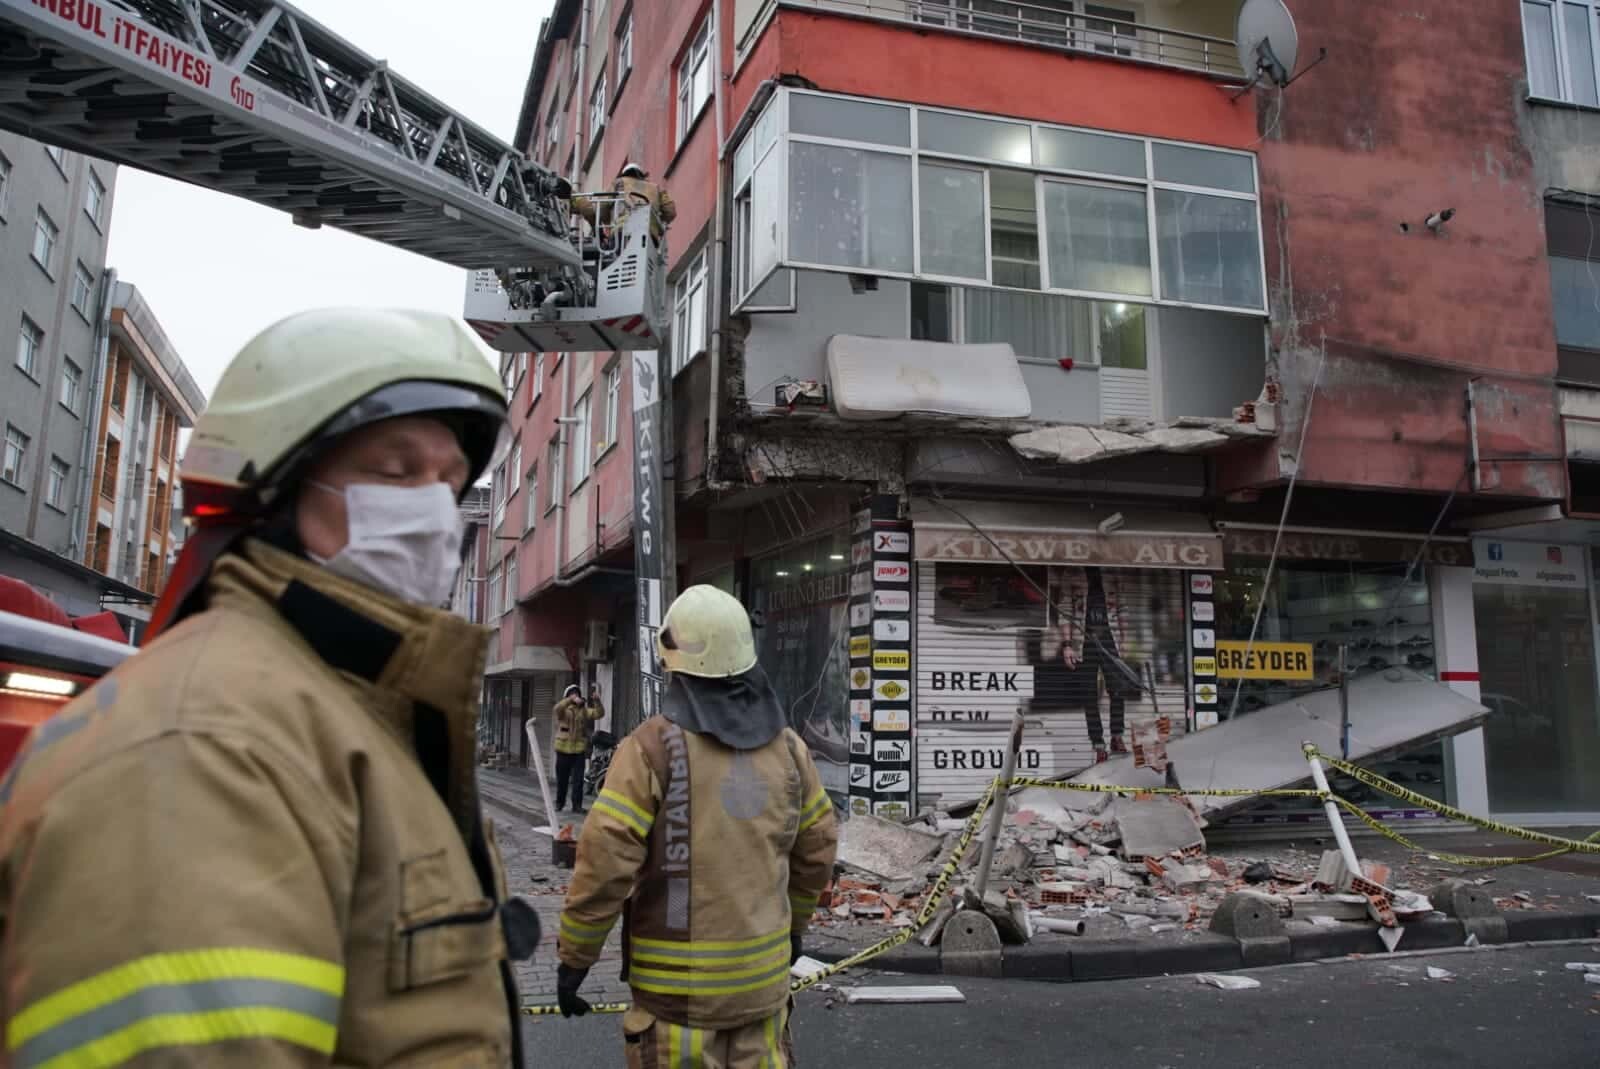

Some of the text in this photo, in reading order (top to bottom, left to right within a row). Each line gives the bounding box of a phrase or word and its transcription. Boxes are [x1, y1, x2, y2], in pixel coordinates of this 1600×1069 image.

[875, 656, 906, 664] GREYDER
[1217, 648, 1307, 672] GREYDER
[932, 672, 1018, 691] BREAK
[877, 750, 900, 760] PUMA
[880, 773, 902, 782] NIKE
